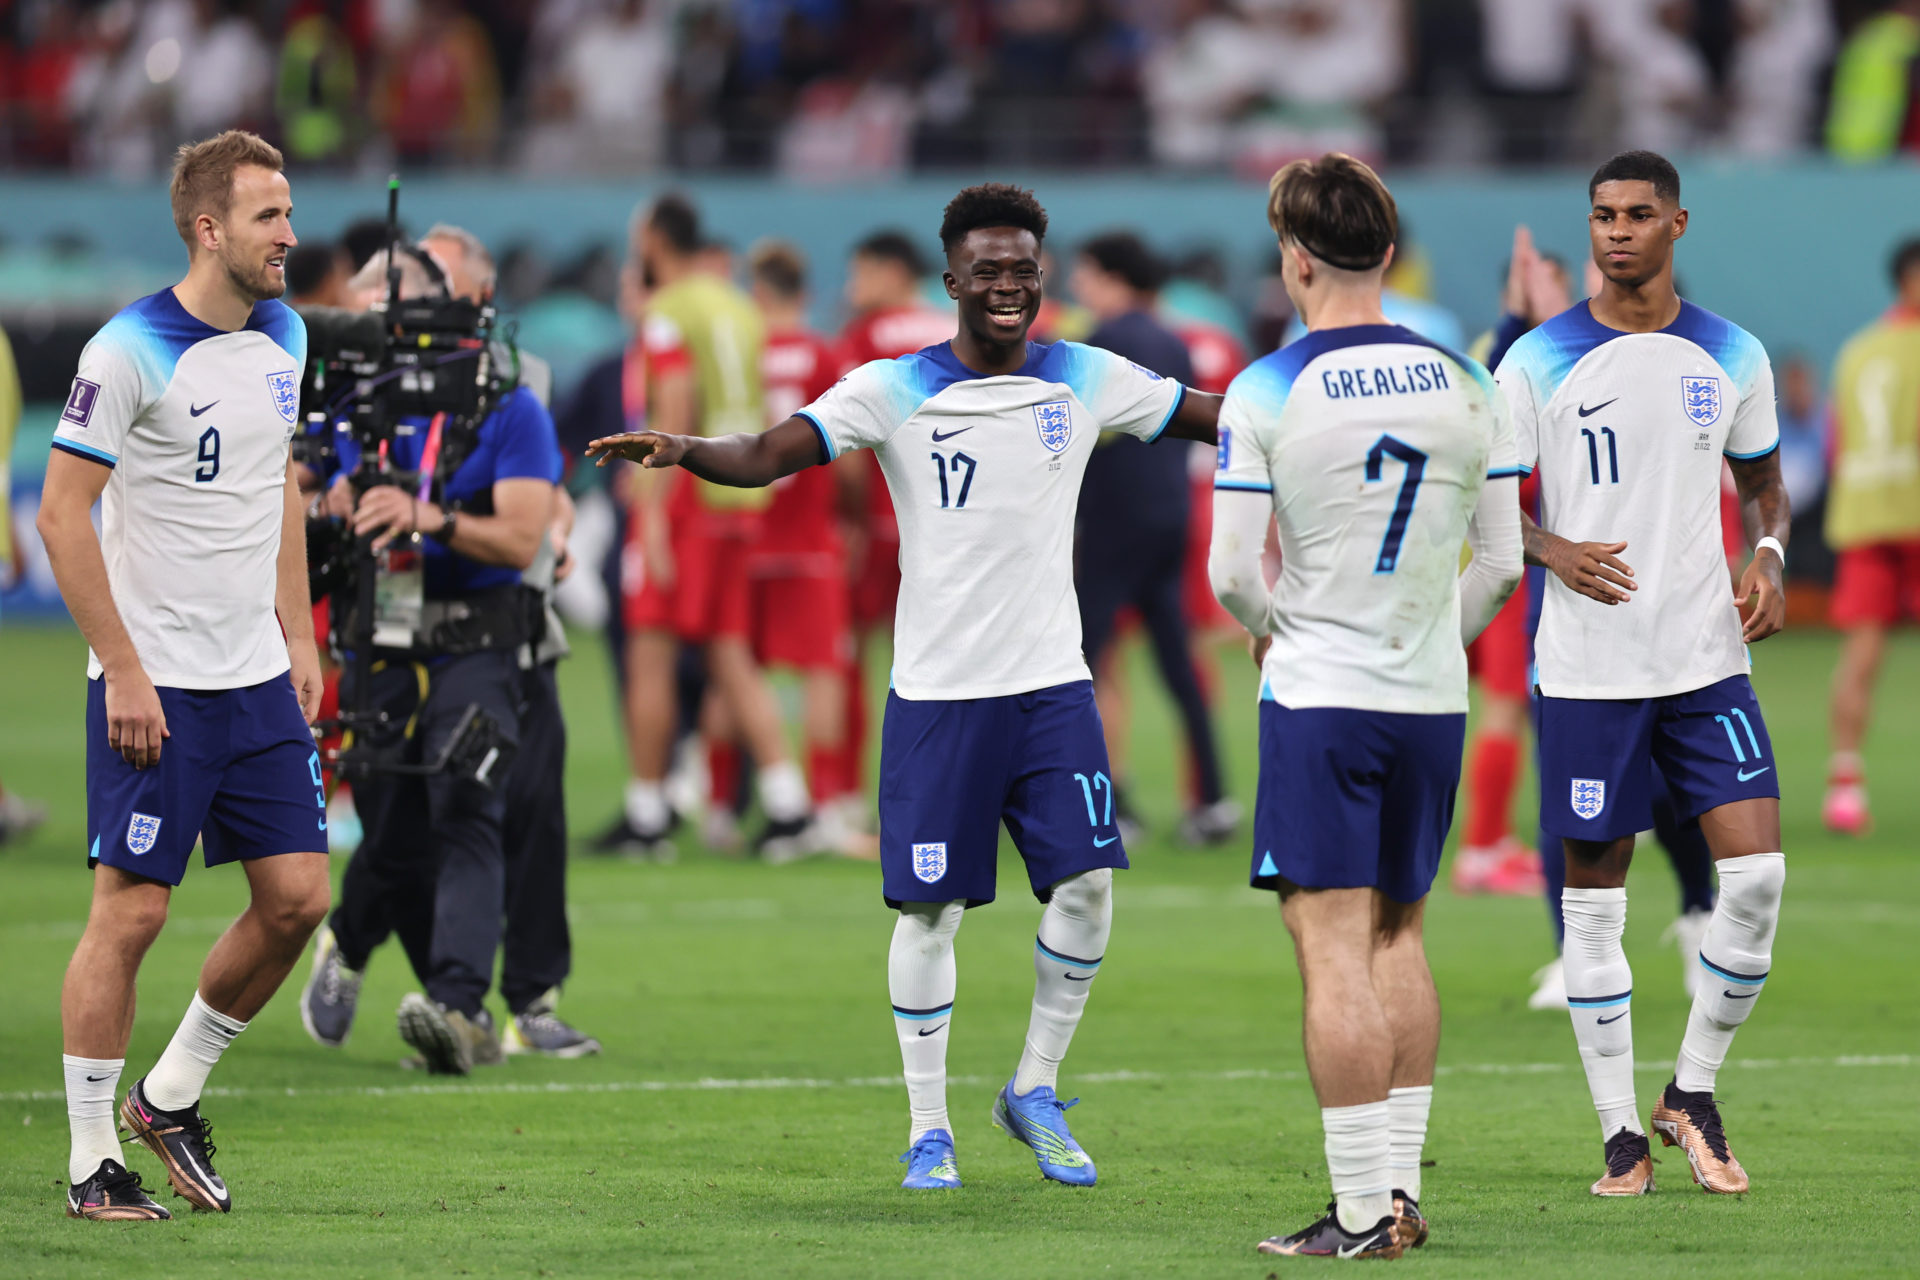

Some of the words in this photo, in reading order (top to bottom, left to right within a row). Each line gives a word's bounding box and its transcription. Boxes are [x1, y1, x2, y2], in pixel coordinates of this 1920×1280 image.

[195, 425, 220, 483] 9
[931, 451, 977, 508] 17
[1581, 426, 1619, 485] 11
[1364, 432, 1430, 575] 7
[1714, 707, 1762, 763] 11
[307, 750, 326, 808] 9
[1073, 770, 1111, 827] 17
